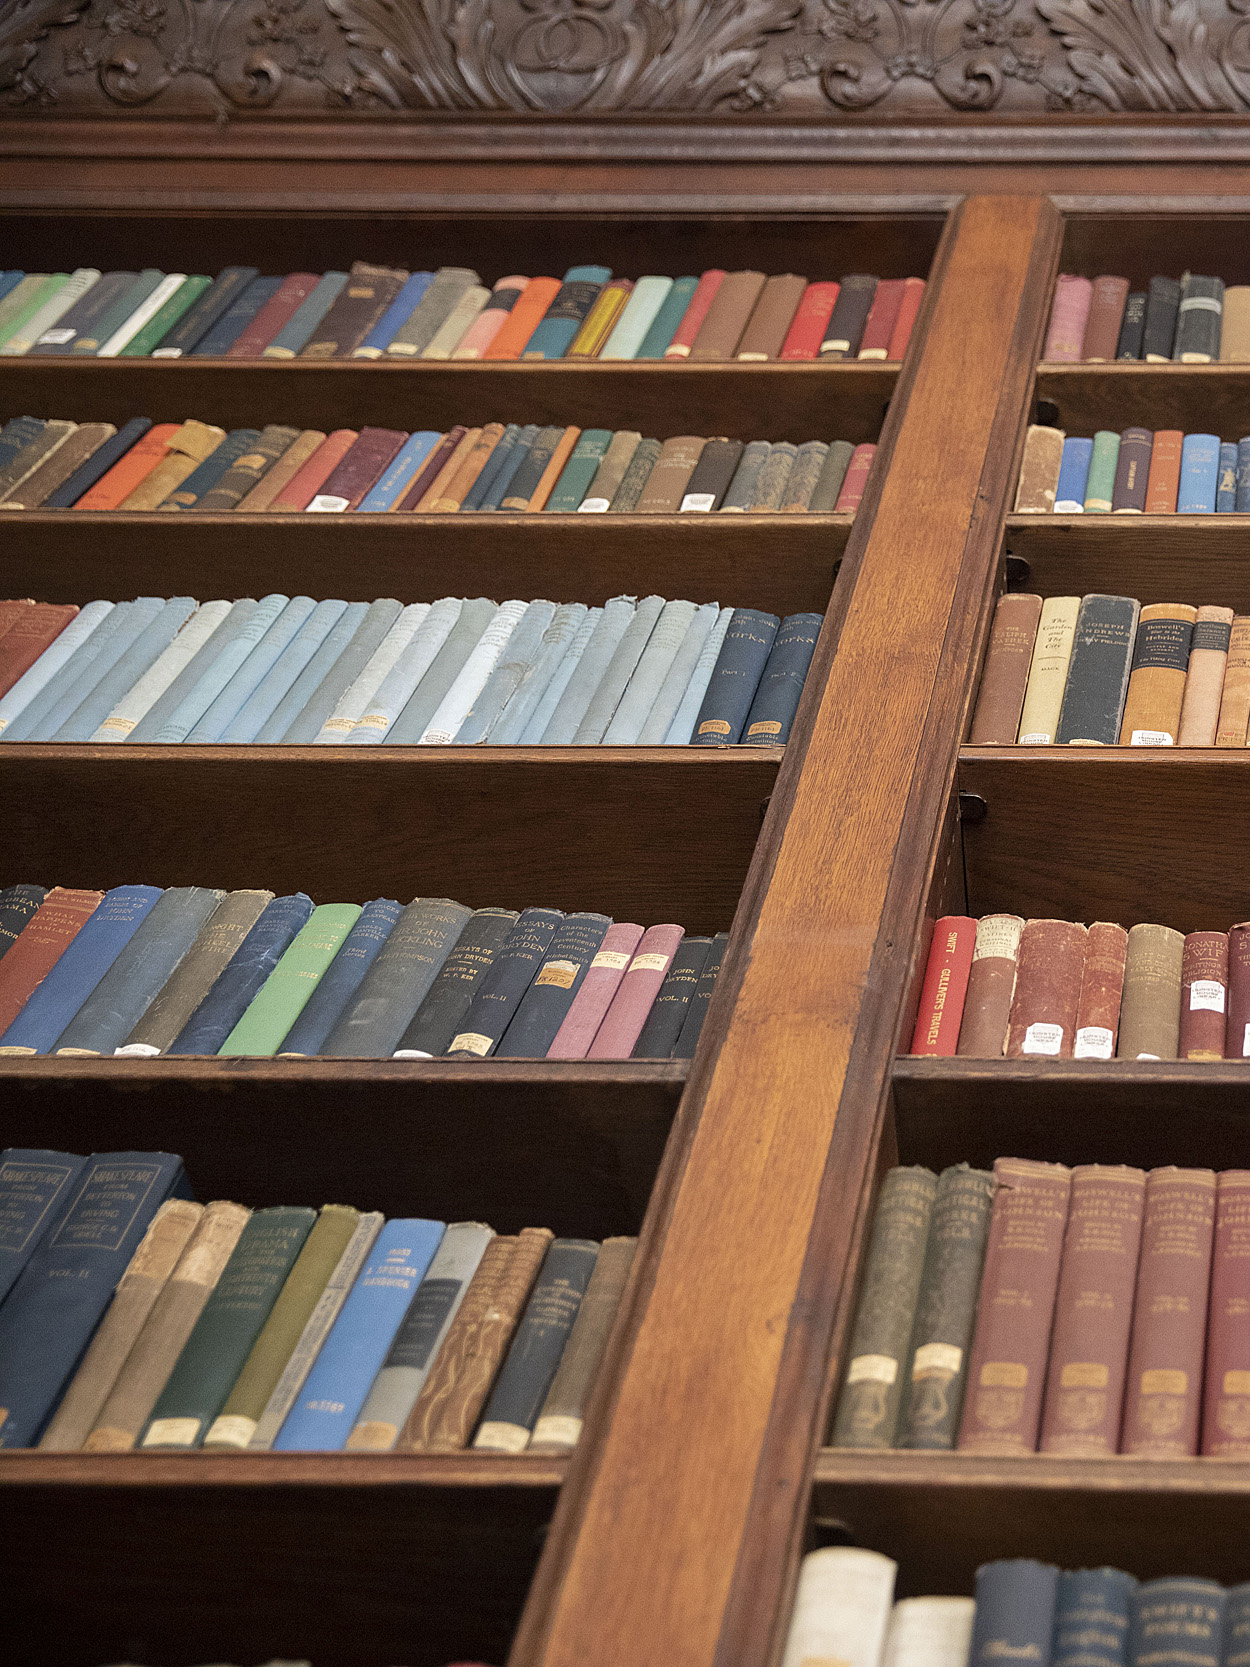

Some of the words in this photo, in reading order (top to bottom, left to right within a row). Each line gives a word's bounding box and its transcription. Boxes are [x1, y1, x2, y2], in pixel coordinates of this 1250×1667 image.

[32, 915, 81, 927] HAPPENS
[420, 913, 457, 924] WORKS
[29, 924, 73, 935] HAMLET
[515, 920, 555, 930] ESSAYS
[560, 925, 603, 935] Characters
[413, 928, 448, 939] JOHN
[509, 934, 541, 943] JOHN
[498, 941, 545, 952] DRYDEN
[554, 938, 597, 948] Seventeenth
[945, 931, 958, 953] SWIFT
[1185, 940, 1229, 953] JONATHA
[557, 944, 590, 953] Century
[464, 953, 494, 965] DRYDEN
[516, 952, 533, 960] KER
[1183, 948, 1224, 961] SWIF
[469, 967, 478, 975] BY
[461, 973, 474, 981] KER
[665, 976, 699, 984] DRYDEN
[933, 968, 951, 1010] GULLIVER'S
[926, 1011, 943, 1045] TRAVELS
